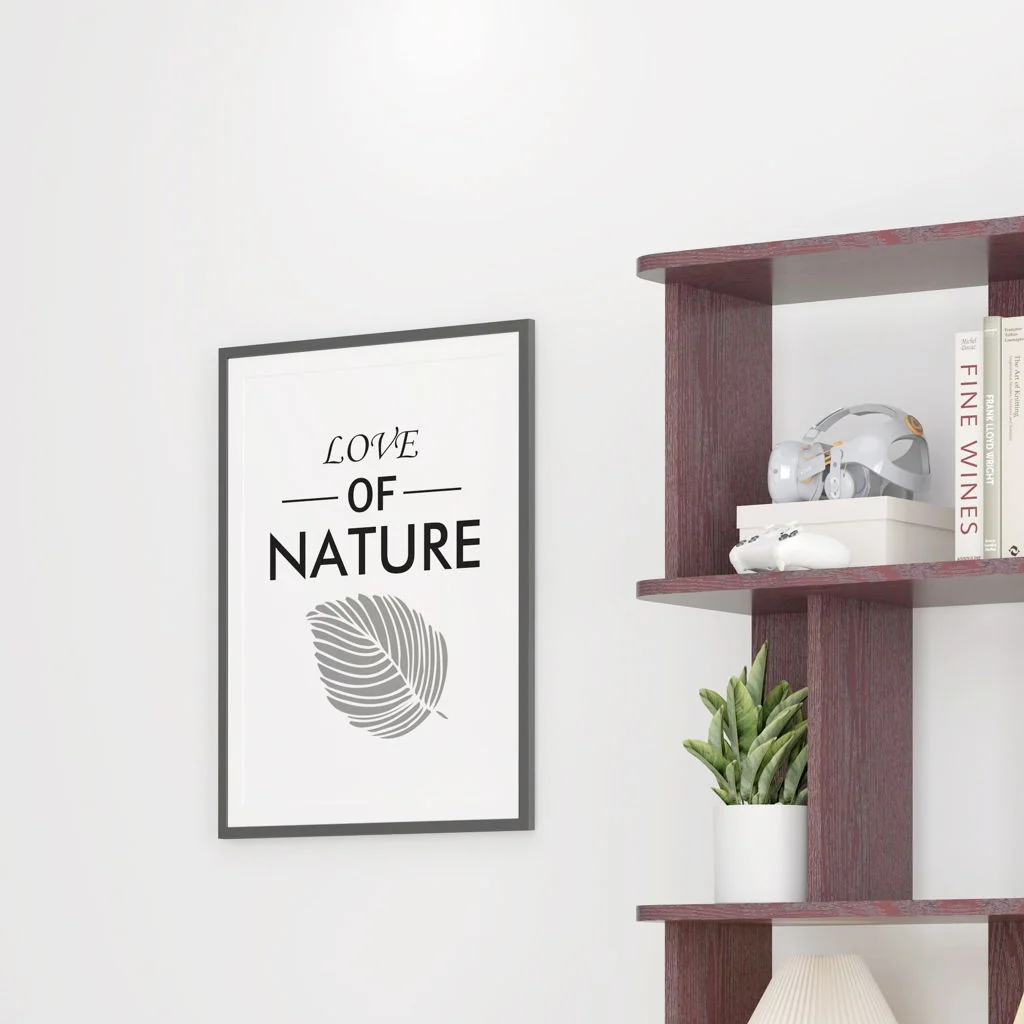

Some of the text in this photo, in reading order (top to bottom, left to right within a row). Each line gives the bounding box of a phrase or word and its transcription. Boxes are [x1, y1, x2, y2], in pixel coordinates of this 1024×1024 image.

[960, 365, 978, 426] FINE
[323, 426, 419, 464] LOVE
[986, 394, 994, 485] FRANK LLOYD WRIGHT
[348, 475, 397, 513] OF
[960, 440, 978, 535] WINES
[269, 519, 480, 580] NATURE
